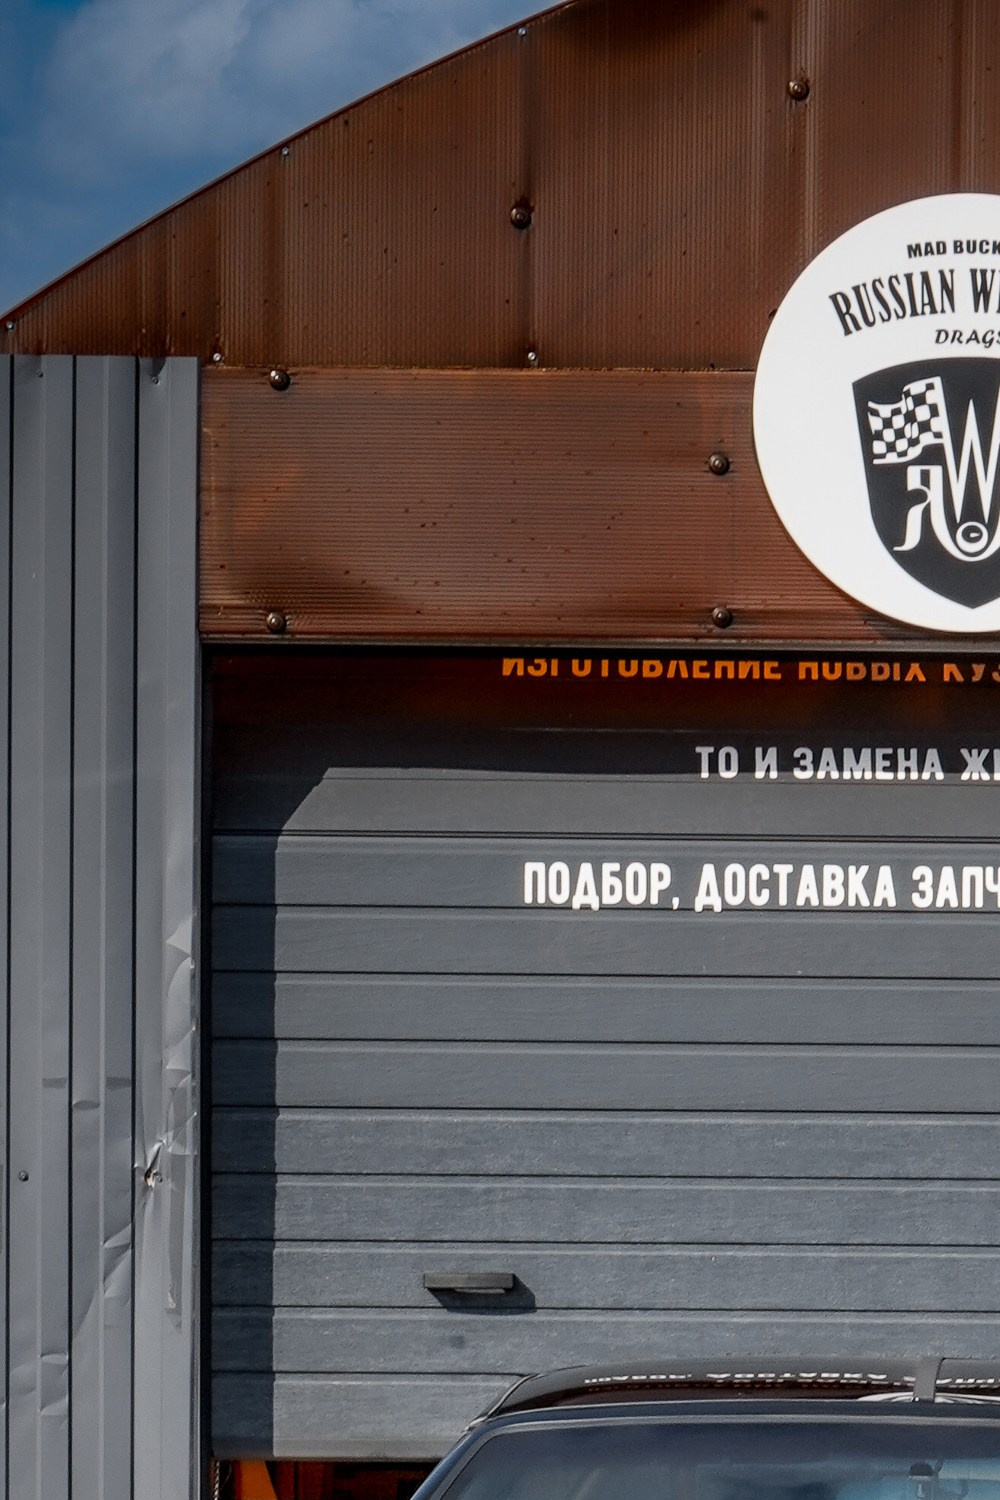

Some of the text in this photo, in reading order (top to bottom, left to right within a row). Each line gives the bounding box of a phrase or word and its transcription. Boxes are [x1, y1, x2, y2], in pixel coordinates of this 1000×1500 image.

[906, 240, 948, 259] MAD
[828, 268, 956, 337] RUSSIAN
[694, 745, 739, 780] ТО
[754, 746, 778, 780] И
[792, 746, 945, 782] ЗАМЕНА
[523, 860, 680, 911] ПОДБОР,
[694, 862, 897, 913] ДОСТАВКА
